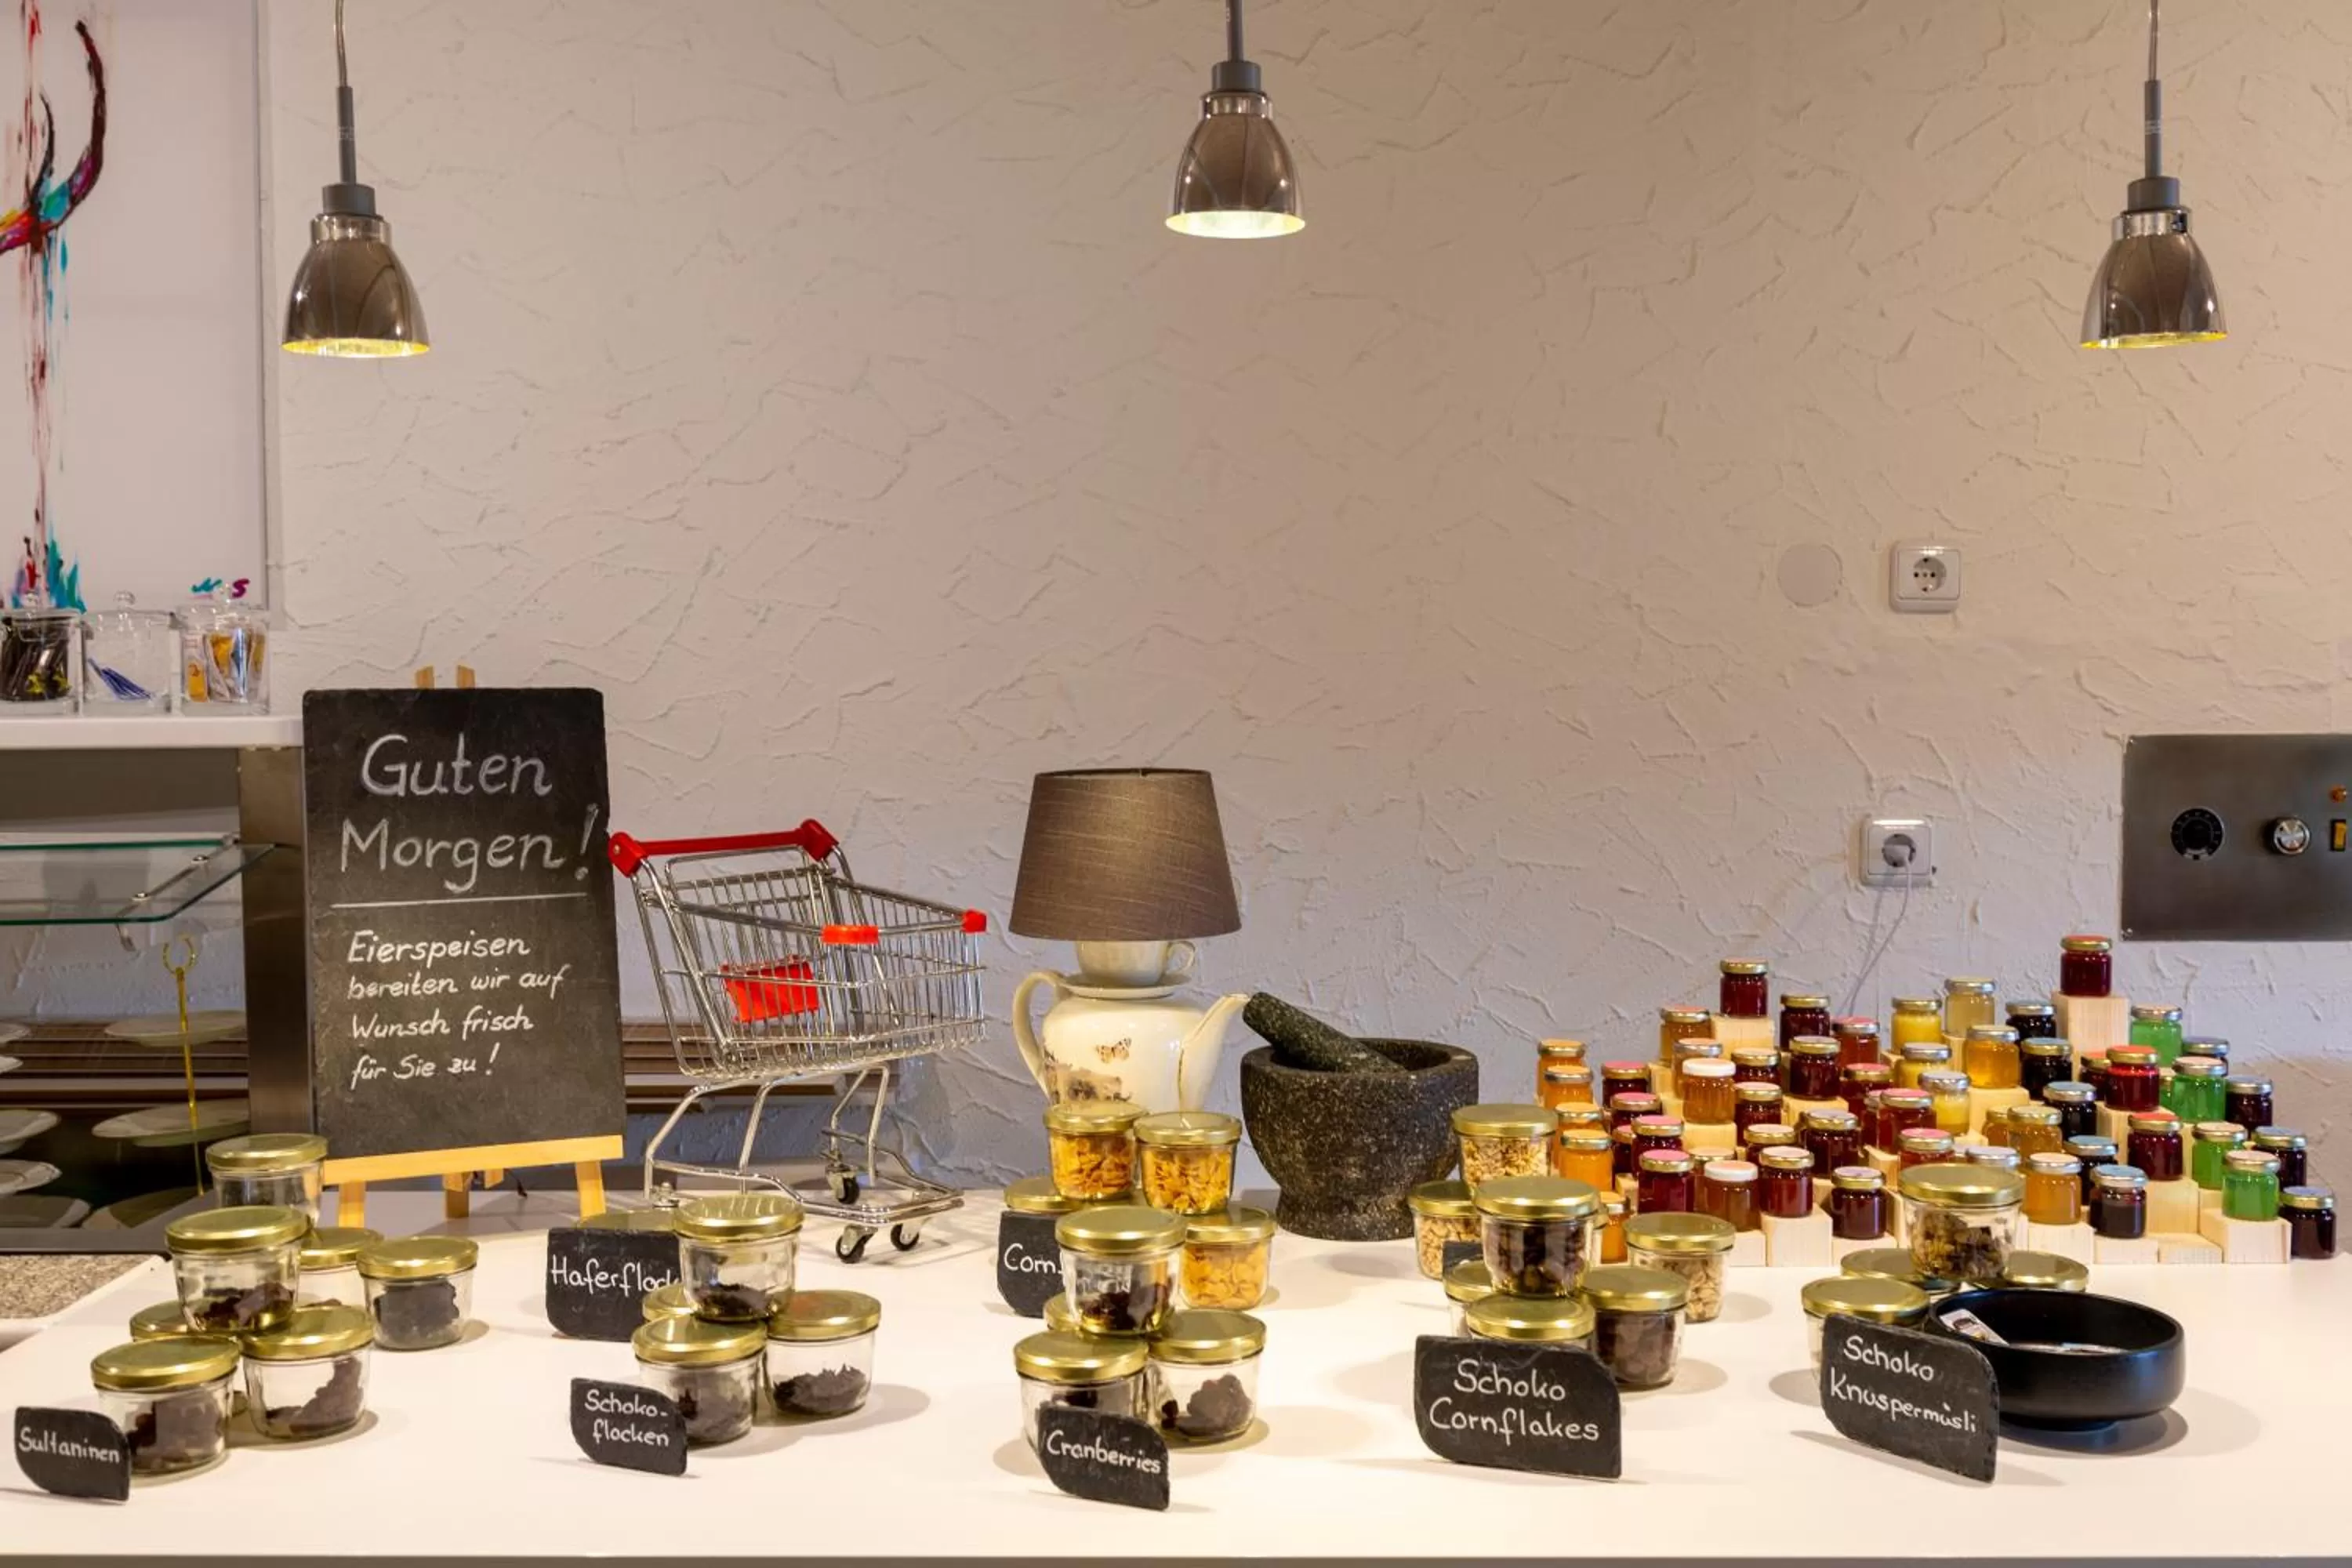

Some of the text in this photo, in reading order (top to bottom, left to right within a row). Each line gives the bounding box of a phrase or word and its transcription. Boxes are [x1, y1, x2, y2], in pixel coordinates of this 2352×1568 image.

[361, 731, 553, 797] Guten
[340, 802, 600, 894] Morgen!
[347, 929, 532, 970] Eierspeisen
[347, 963, 572, 1000] bereiten wir auf
[352, 1003, 535, 1042] Wunsch frisch
[350, 1054, 387, 1091] für
[392, 1053, 437, 1080] Sie
[1842, 1334, 1935, 1381] Schoko
[1453, 1358, 1566, 1402] Schoko
[584, 1388, 669, 1417] Schoko-
[1428, 1396, 1600, 1446] Cornflakes
[18, 1425, 121, 1464] Sultaninen
[592, 1417, 670, 1447] flocken
[1046, 1429, 1162, 1475] Cranberries
